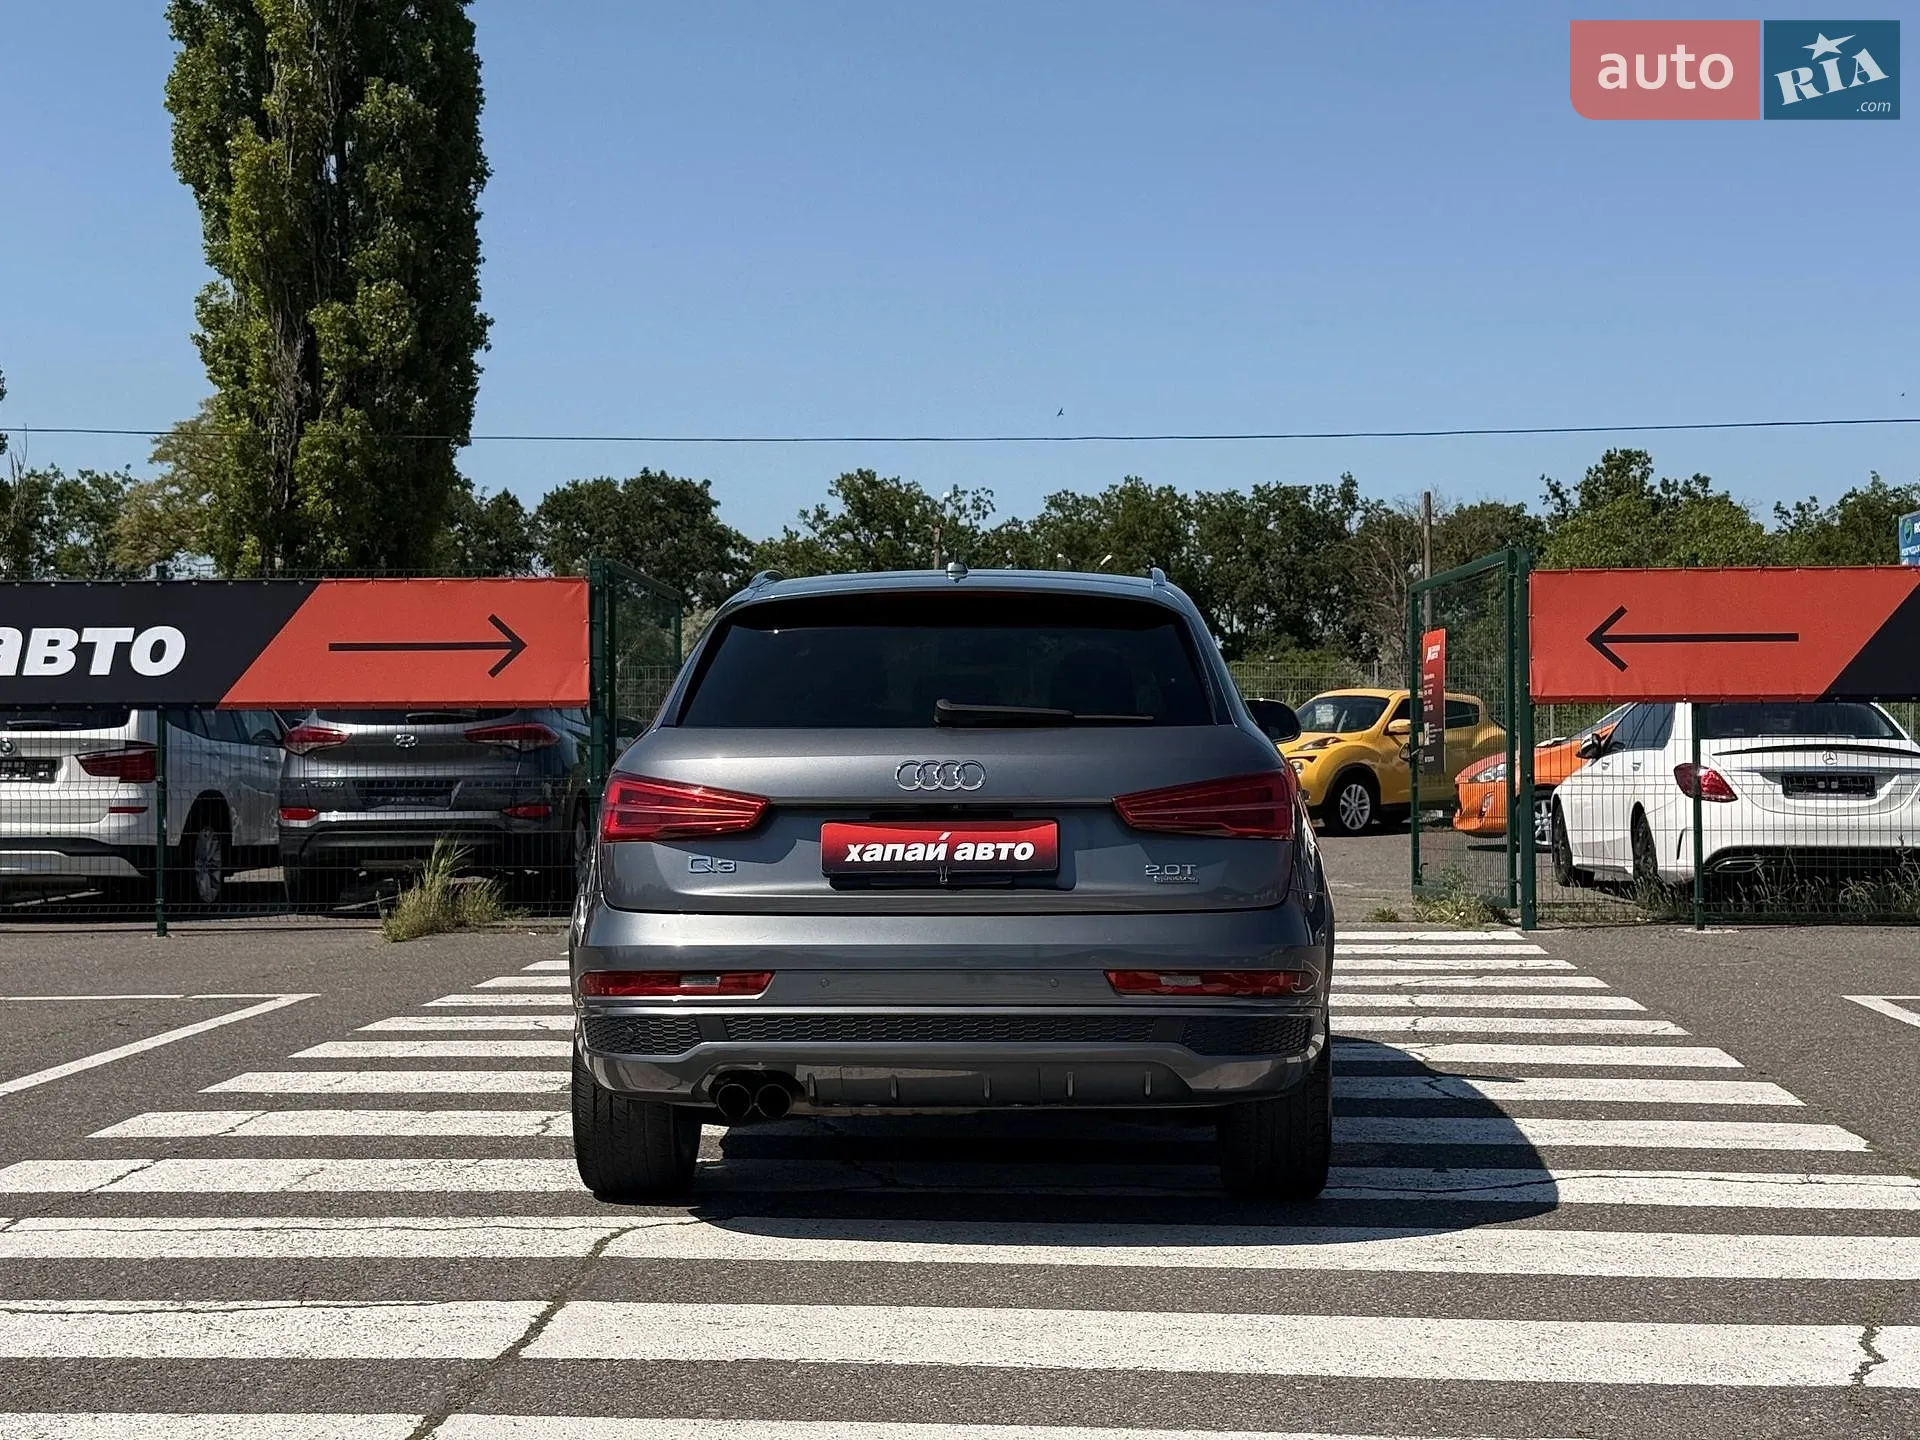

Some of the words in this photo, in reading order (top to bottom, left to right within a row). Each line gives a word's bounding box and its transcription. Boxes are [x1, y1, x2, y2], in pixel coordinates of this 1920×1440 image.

[844, 831, 951, 862] хапай
[953, 842, 1035, 861] авто
[688, 855, 736, 873] Q3
[1144, 864, 1197, 875] 2.0T
